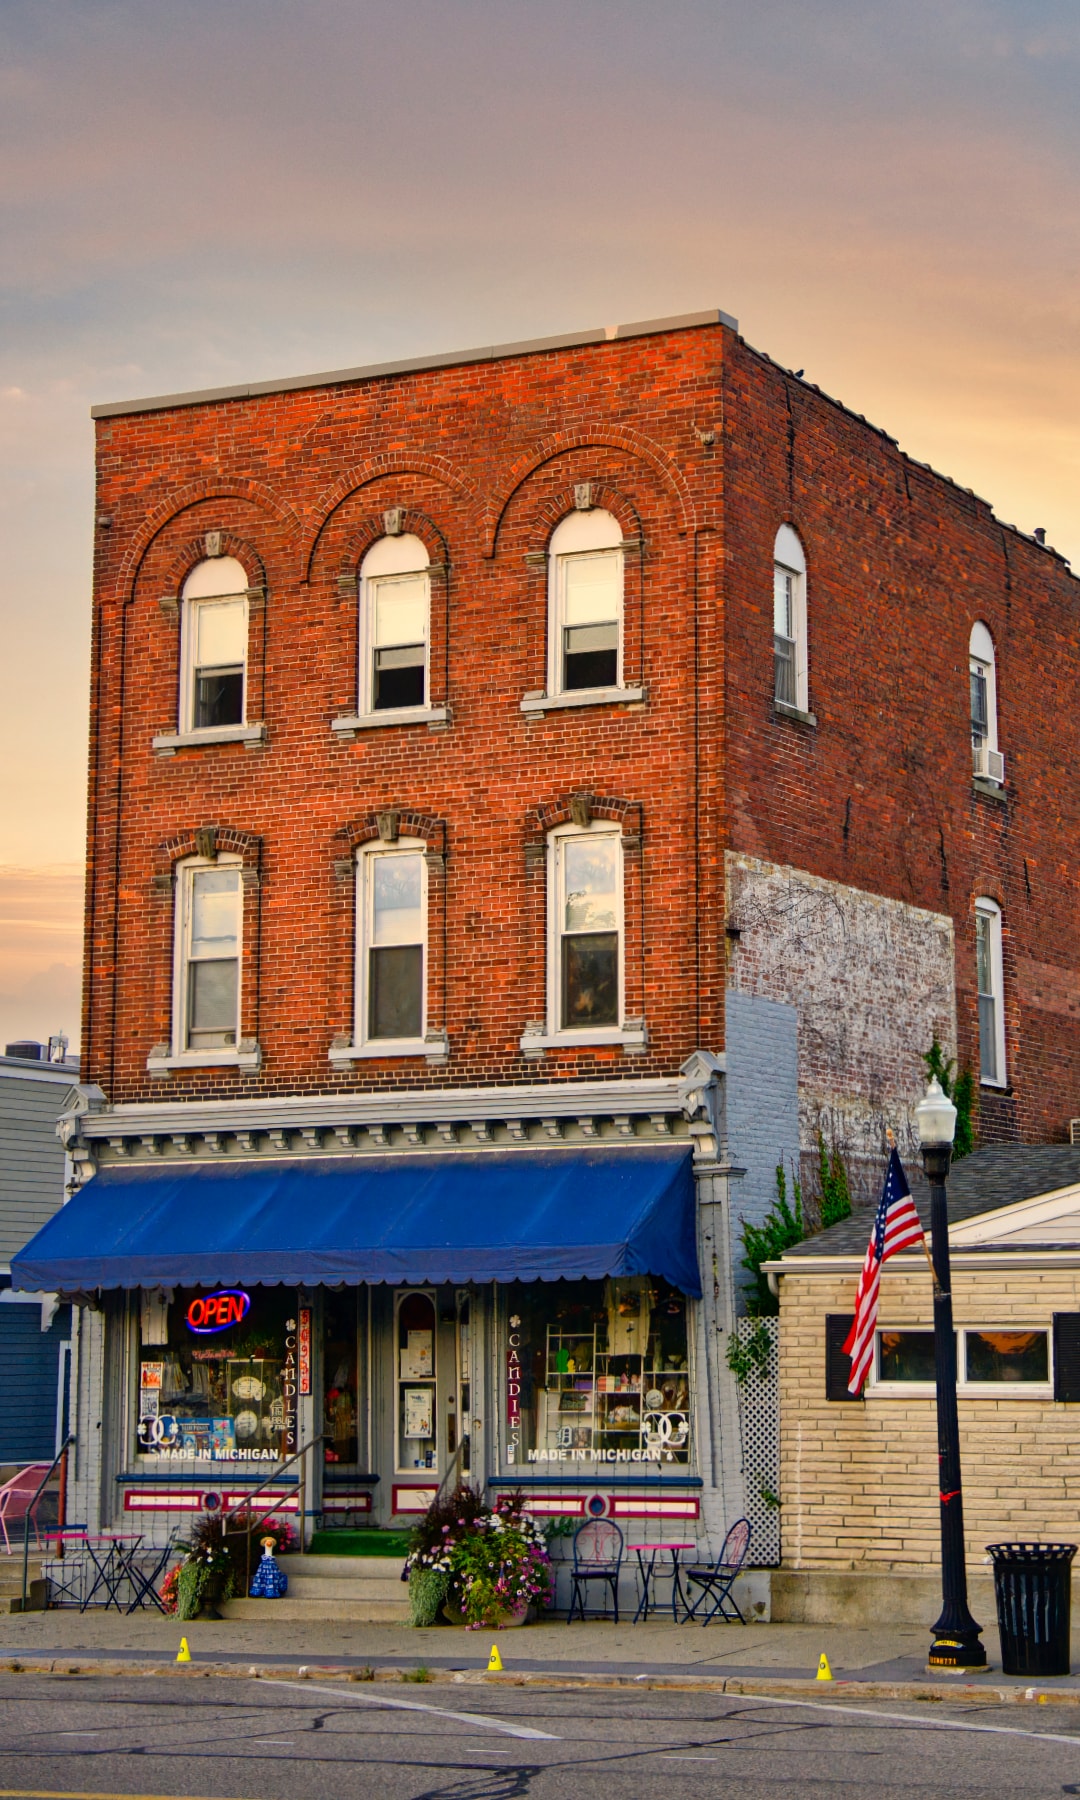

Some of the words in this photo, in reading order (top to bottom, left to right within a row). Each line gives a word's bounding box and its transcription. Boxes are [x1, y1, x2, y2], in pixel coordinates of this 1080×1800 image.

[187, 1296, 245, 1326] OPEN
[285, 1335, 296, 1445] CANDLES
[508, 1333, 521, 1447] CANDIES
[160, 1448, 197, 1460] MADE
[199, 1448, 212, 1460] IN
[215, 1448, 279, 1460] MICHIGAN
[528, 1449, 568, 1461] MADE
[571, 1449, 586, 1461] IN
[591, 1449, 662, 1461] MICHIGAN
